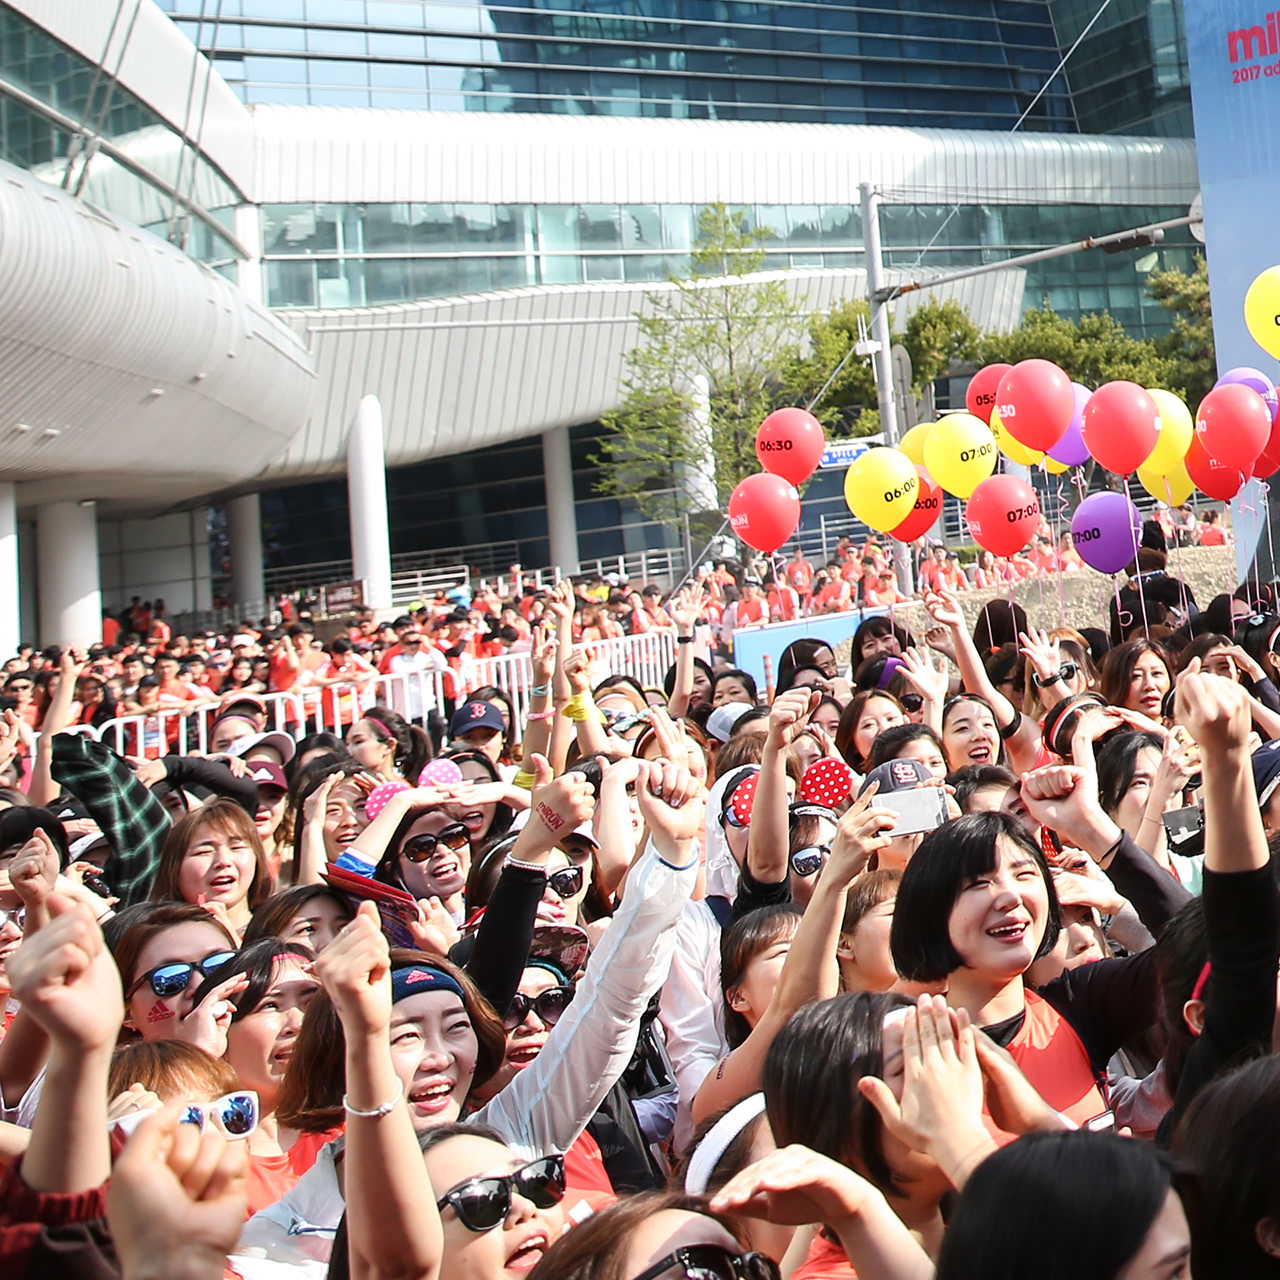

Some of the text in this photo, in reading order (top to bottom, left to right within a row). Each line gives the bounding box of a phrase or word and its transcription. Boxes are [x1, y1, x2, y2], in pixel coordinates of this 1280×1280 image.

[1232, 65, 1262, 84] 2017
[760, 439, 793, 451] 06:30
[960, 443, 992, 462] 07:00
[884, 478, 916, 502] 06:00
[1007, 502, 1038, 522] 07:00
